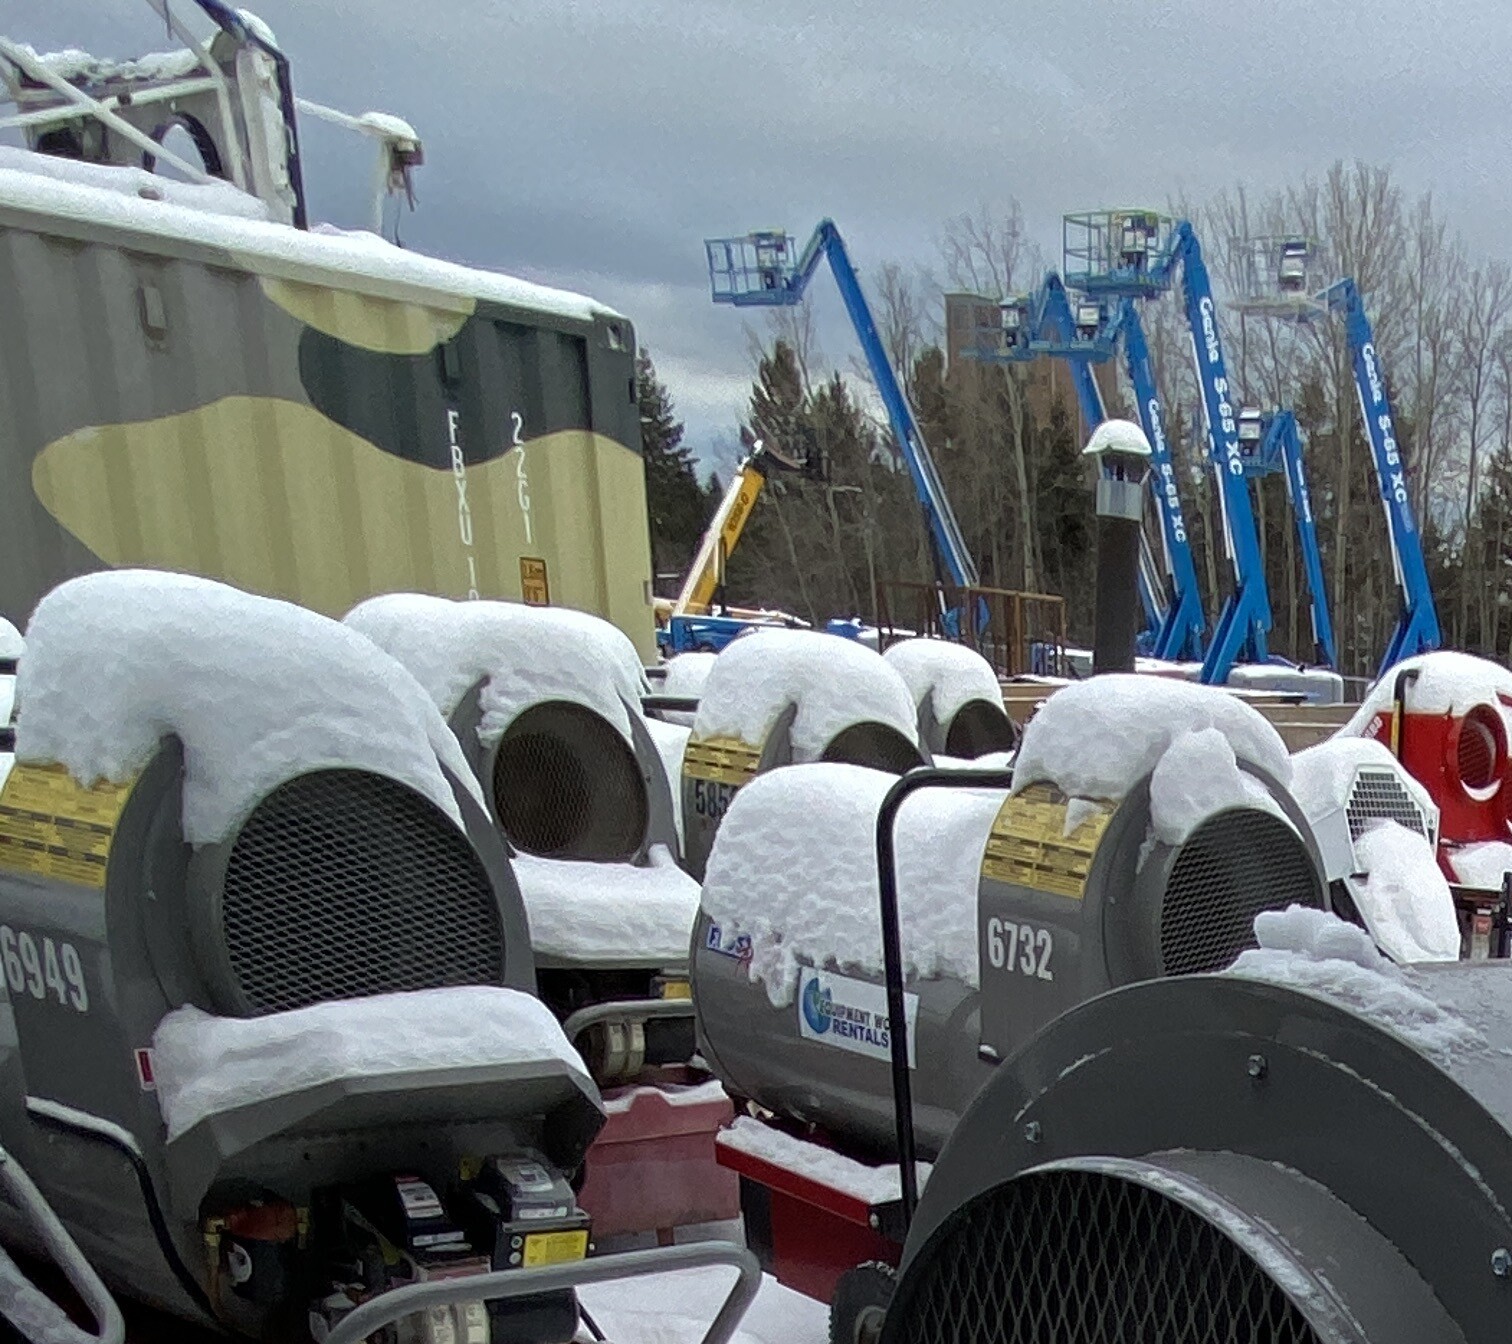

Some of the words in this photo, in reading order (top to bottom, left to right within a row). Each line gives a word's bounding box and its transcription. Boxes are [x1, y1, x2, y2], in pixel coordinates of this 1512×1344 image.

[1199, 296, 1220, 363] Genie
[1213, 376, 1237, 433] S-65
[1225, 440, 1243, 475] XC
[1362, 343, 1383, 406] Genie
[1389, 471, 1408, 503] XC
[447, 409, 474, 546] FBXU
[0, 924, 89, 1013] 6949
[987, 917, 1053, 981] 6732
[832, 1018, 890, 1048] RENTALS
